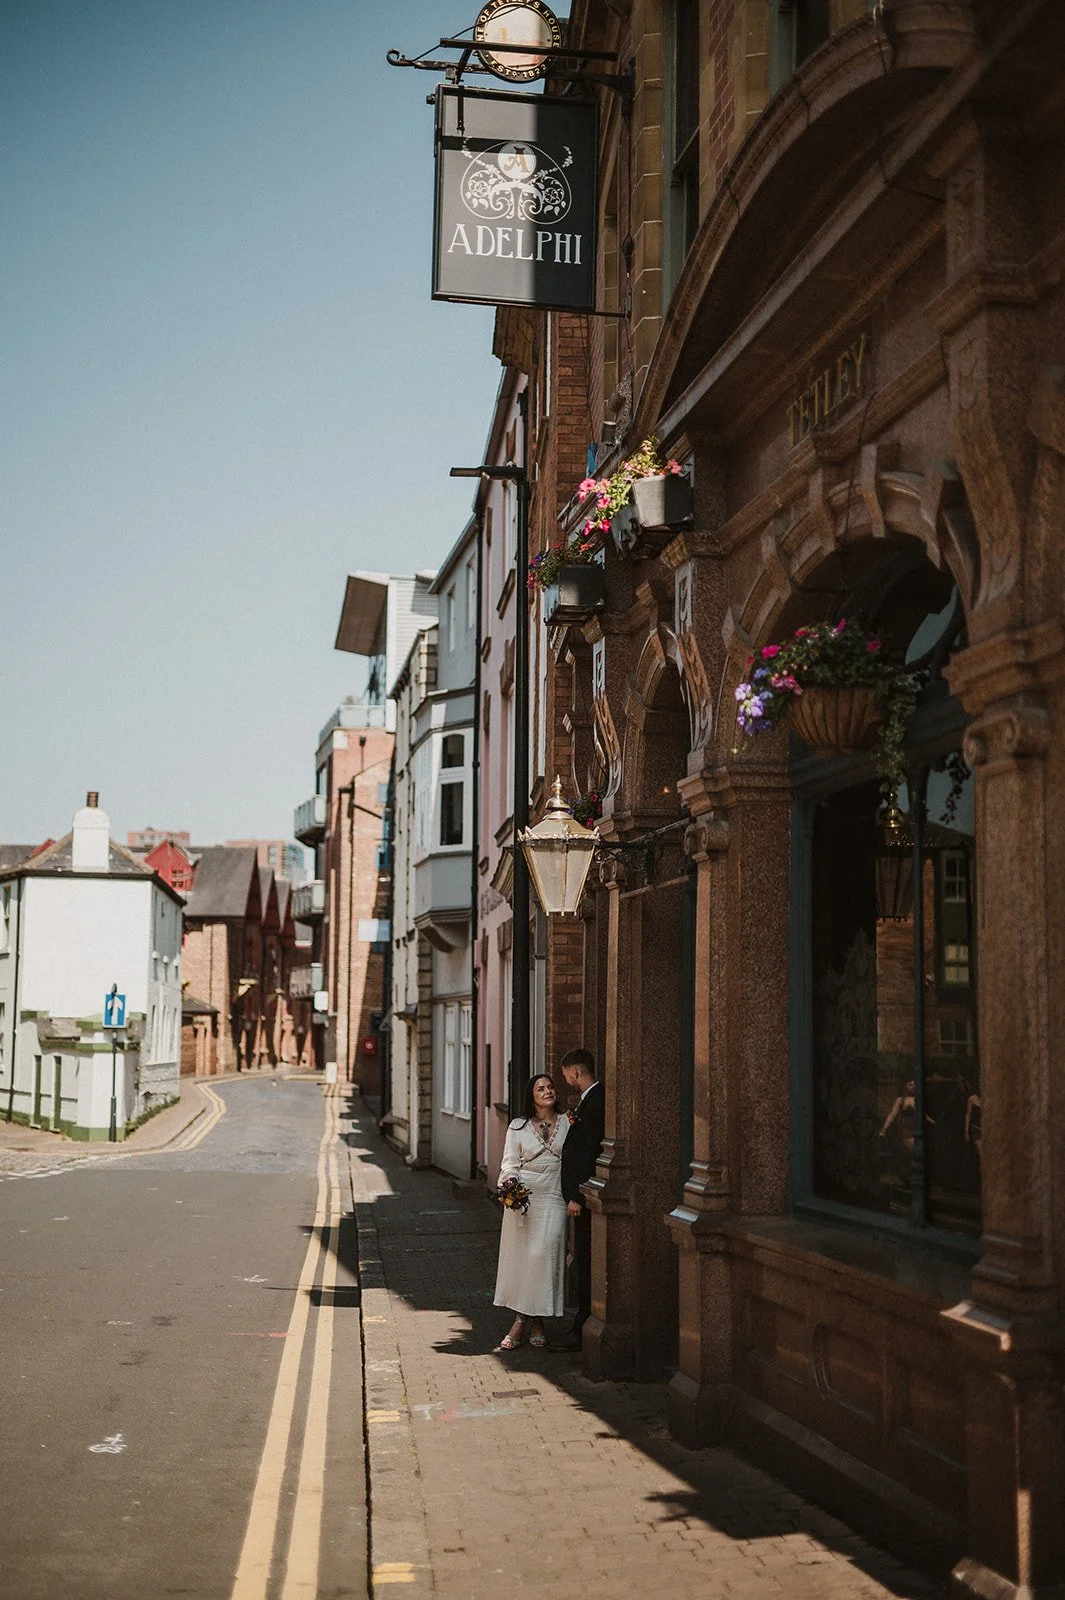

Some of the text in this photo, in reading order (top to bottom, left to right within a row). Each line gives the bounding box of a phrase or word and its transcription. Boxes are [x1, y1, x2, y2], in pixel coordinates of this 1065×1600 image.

[480, 9, 491, 23] OF
[523, 63, 547, 78] 1822
[447, 223, 583, 265] ADELPHI
[786, 332, 866, 450] TETLEY
